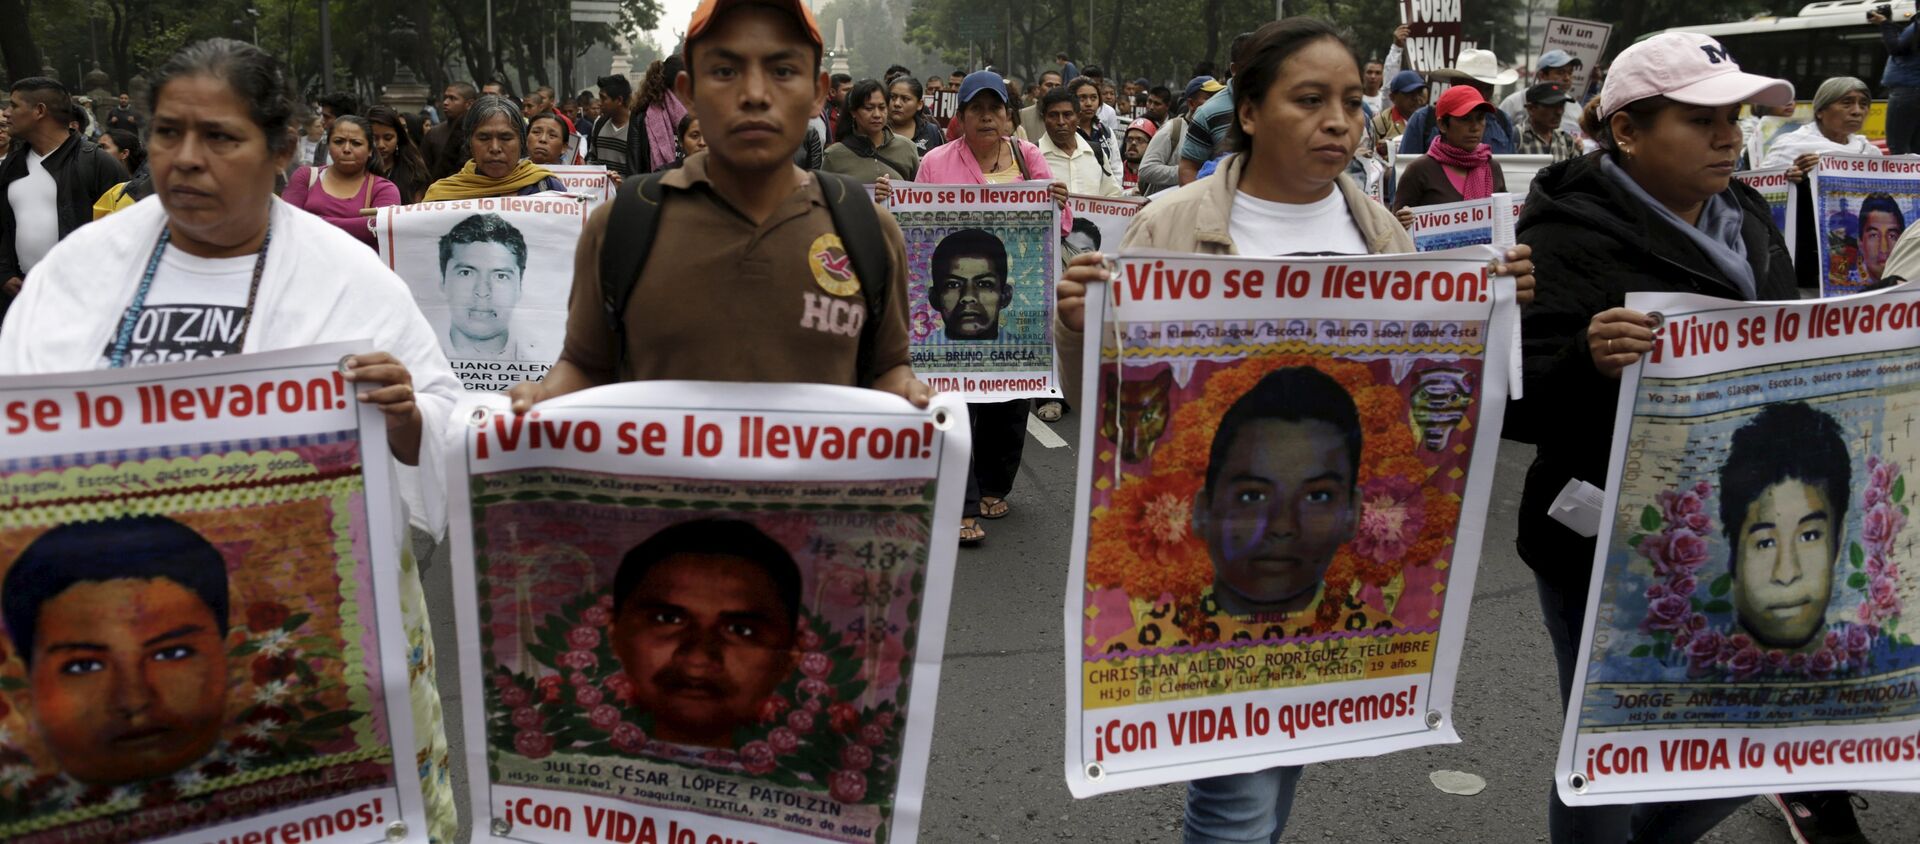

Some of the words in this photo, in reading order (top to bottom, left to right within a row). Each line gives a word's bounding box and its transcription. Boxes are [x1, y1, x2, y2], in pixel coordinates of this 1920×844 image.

[1549, 37, 1598, 50] Desaparecido
[1576, 29, 1593, 39] un
[1852, 160, 1864, 171] se
[1868, 160, 1878, 172] lo
[563, 177, 604, 188] varon!
[478, 197, 494, 210] lo
[501, 197, 579, 215] llevaron!
[890, 189, 932, 206] ¡Vivo
[938, 191, 955, 203] se
[960, 189, 975, 203] lo
[980, 189, 1050, 203] llevaron!
[1075, 200, 1085, 212] lo
[1415, 213, 1450, 231] ¡Vivo
[1454, 211, 1468, 224] se
[1472, 208, 1483, 221] lo
[1114, 260, 1211, 306] ¡Vivo
[1223, 267, 1262, 299] se
[1276, 265, 1310, 299] lo
[1322, 265, 1489, 303] llevaron!
[1142, 328, 1161, 340] Jan
[1167, 327, 1205, 340] Nimmo,
[1207, 327, 1259, 340] Glasgow,
[1267, 326, 1317, 340] Escocia,
[1326, 327, 1367, 339] quiero
[1374, 326, 1407, 337] saber
[1451, 326, 1477, 337] está
[1650, 315, 1729, 364] ¡Vivo
[1738, 316, 1765, 348] se
[1774, 308, 1800, 343] lo
[451, 361, 501, 371] LIANO
[945, 351, 983, 362] BRUNO
[990, 348, 1036, 361] GARCÍA
[464, 383, 508, 392] CRUZ
[928, 377, 960, 393] VIDA
[964, 377, 975, 393] lo
[980, 376, 1046, 395] queremos!
[1648, 392, 1664, 404] Yo
[1672, 394, 1691, 404] Jan
[1696, 389, 1723, 402] Nimmo,
[1727, 383, 1764, 396] Glasgow,
[1769, 375, 1807, 389] Escocia,
[1812, 371, 1843, 385] quiero
[1846, 368, 1872, 380] saber
[6, 398, 61, 435] se
[75, 390, 124, 430] lo
[138, 371, 347, 424] llevaron!
[476, 411, 601, 460] ¡Vivo
[617, 421, 667, 457] se
[683, 415, 722, 457] lo
[738, 416, 933, 460] llevaron!
[0, 478, 66, 496] lasgow,
[156, 466, 209, 484] quiero
[217, 457, 260, 476] saber
[520, 474, 544, 484] Jan
[551, 474, 598, 489] Nimmo,
[600, 479, 664, 493] Glasgow,
[673, 484, 736, 497] Escocia,
[746, 485, 794, 498] quiero
[801, 485, 840, 496] saber
[1089, 662, 1178, 685] CHRISTIAN
[1188, 655, 1255, 674] ALFONSO
[1265, 646, 1349, 667] RODRÍGUEZ
[1360, 640, 1430, 658] TELUMBRE
[1100, 686, 1130, 701] Hijo
[1137, 685, 1152, 696] de
[1160, 677, 1217, 694] Clemente
[1224, 678, 1233, 688] y
[1239, 673, 1259, 685] Luz
[1317, 662, 1362, 677] Tixtla,
[1371, 661, 1385, 672] 19
[1390, 658, 1417, 669] años
[1613, 692, 1674, 709] JORGE
[1838, 681, 1918, 703] MENDOZA
[1095, 719, 1156, 761] ¡Con
[1167, 706, 1234, 746] VIDA
[1245, 702, 1270, 736] lo
[1279, 685, 1418, 741] queremos!
[1629, 710, 1656, 722] Hijo
[1663, 711, 1677, 720] de
[1586, 743, 1648, 781] ¡Con
[1660, 737, 1730, 772] VIDA
[1738, 737, 1765, 769] lo
[543, 761, 601, 777] JULIO
[613, 764, 668, 787] CÉSAR
[681, 773, 738, 797] LÓPEZ
[750, 785, 841, 817] PATOLZIN
[508, 771, 539, 783] Hijo
[546, 774, 560, 784] de
[568, 777, 611, 791] Rafael
[618, 786, 626, 795] y
[633, 786, 697, 806] Joaquina,
[706, 797, 754, 817] TIXTLA,
[763, 807, 778, 819] 25
[784, 813, 813, 827] años
[820, 819, 835, 831] de
[842, 825, 872, 839] edad
[505, 798, 571, 832] ¡Con
[583, 805, 658, 844] VIDA
